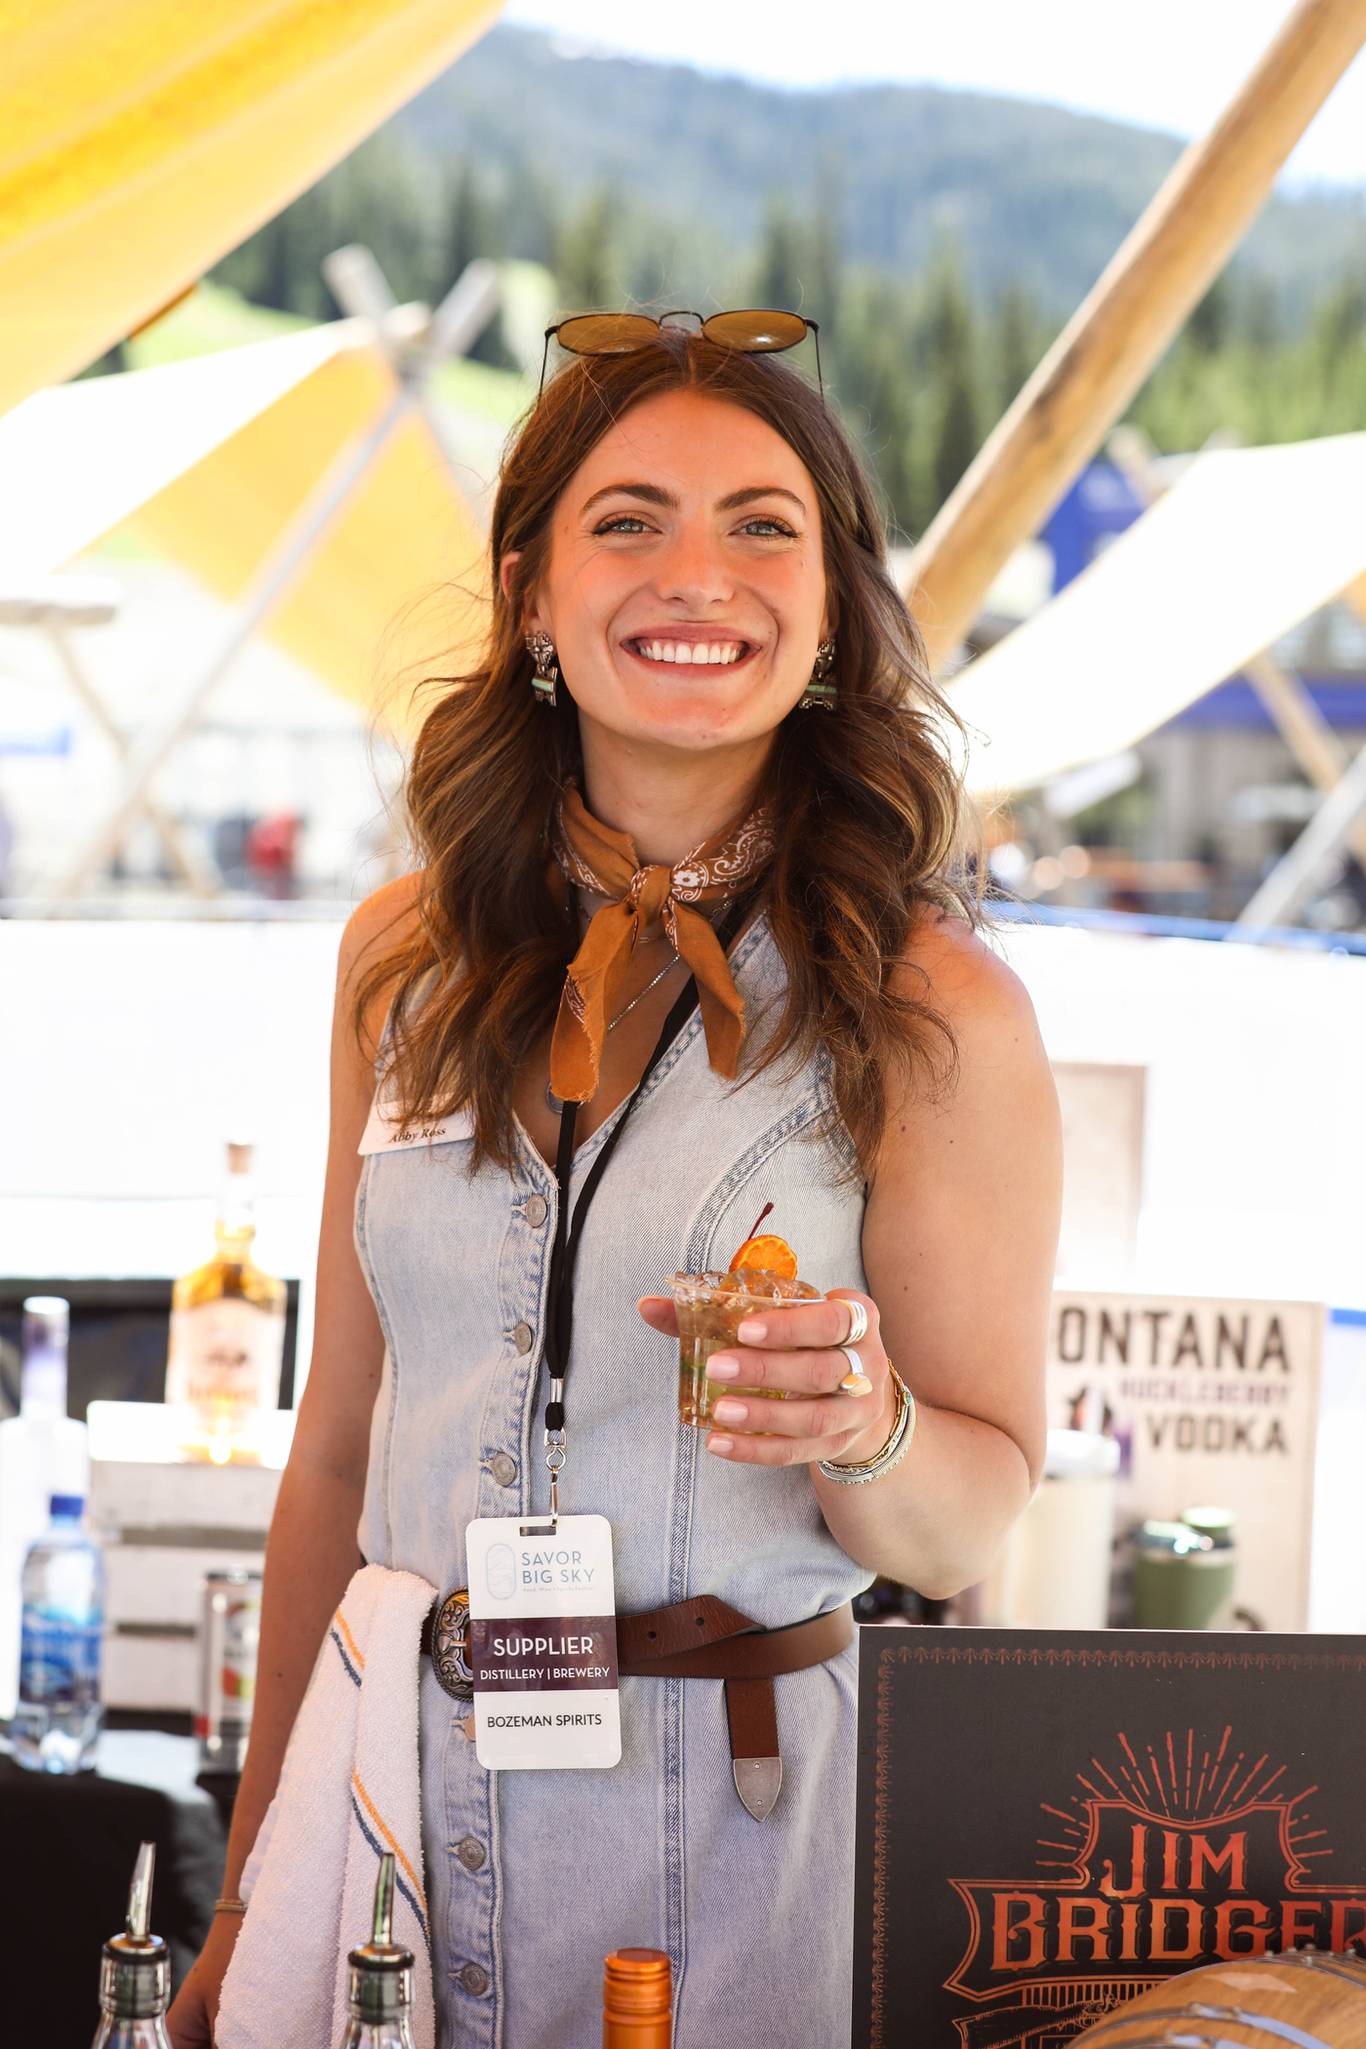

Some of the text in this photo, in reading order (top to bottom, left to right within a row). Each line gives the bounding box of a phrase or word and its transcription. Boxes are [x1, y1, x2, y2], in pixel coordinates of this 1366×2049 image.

[1059, 1307, 1290, 1373] ONTANA
[521, 1551, 582, 1566] SAVOR
[522, 1569, 595, 1584] BIG SKY
[493, 1636, 594, 1657] SUPPLIER
[480, 1667, 544, 1680] DISTILLERY
[553, 1666, 610, 1679] BREWERY
[487, 1714, 602, 1728] BOZEMAN SPIRITS
[1098, 1823, 1249, 1899] JIM
